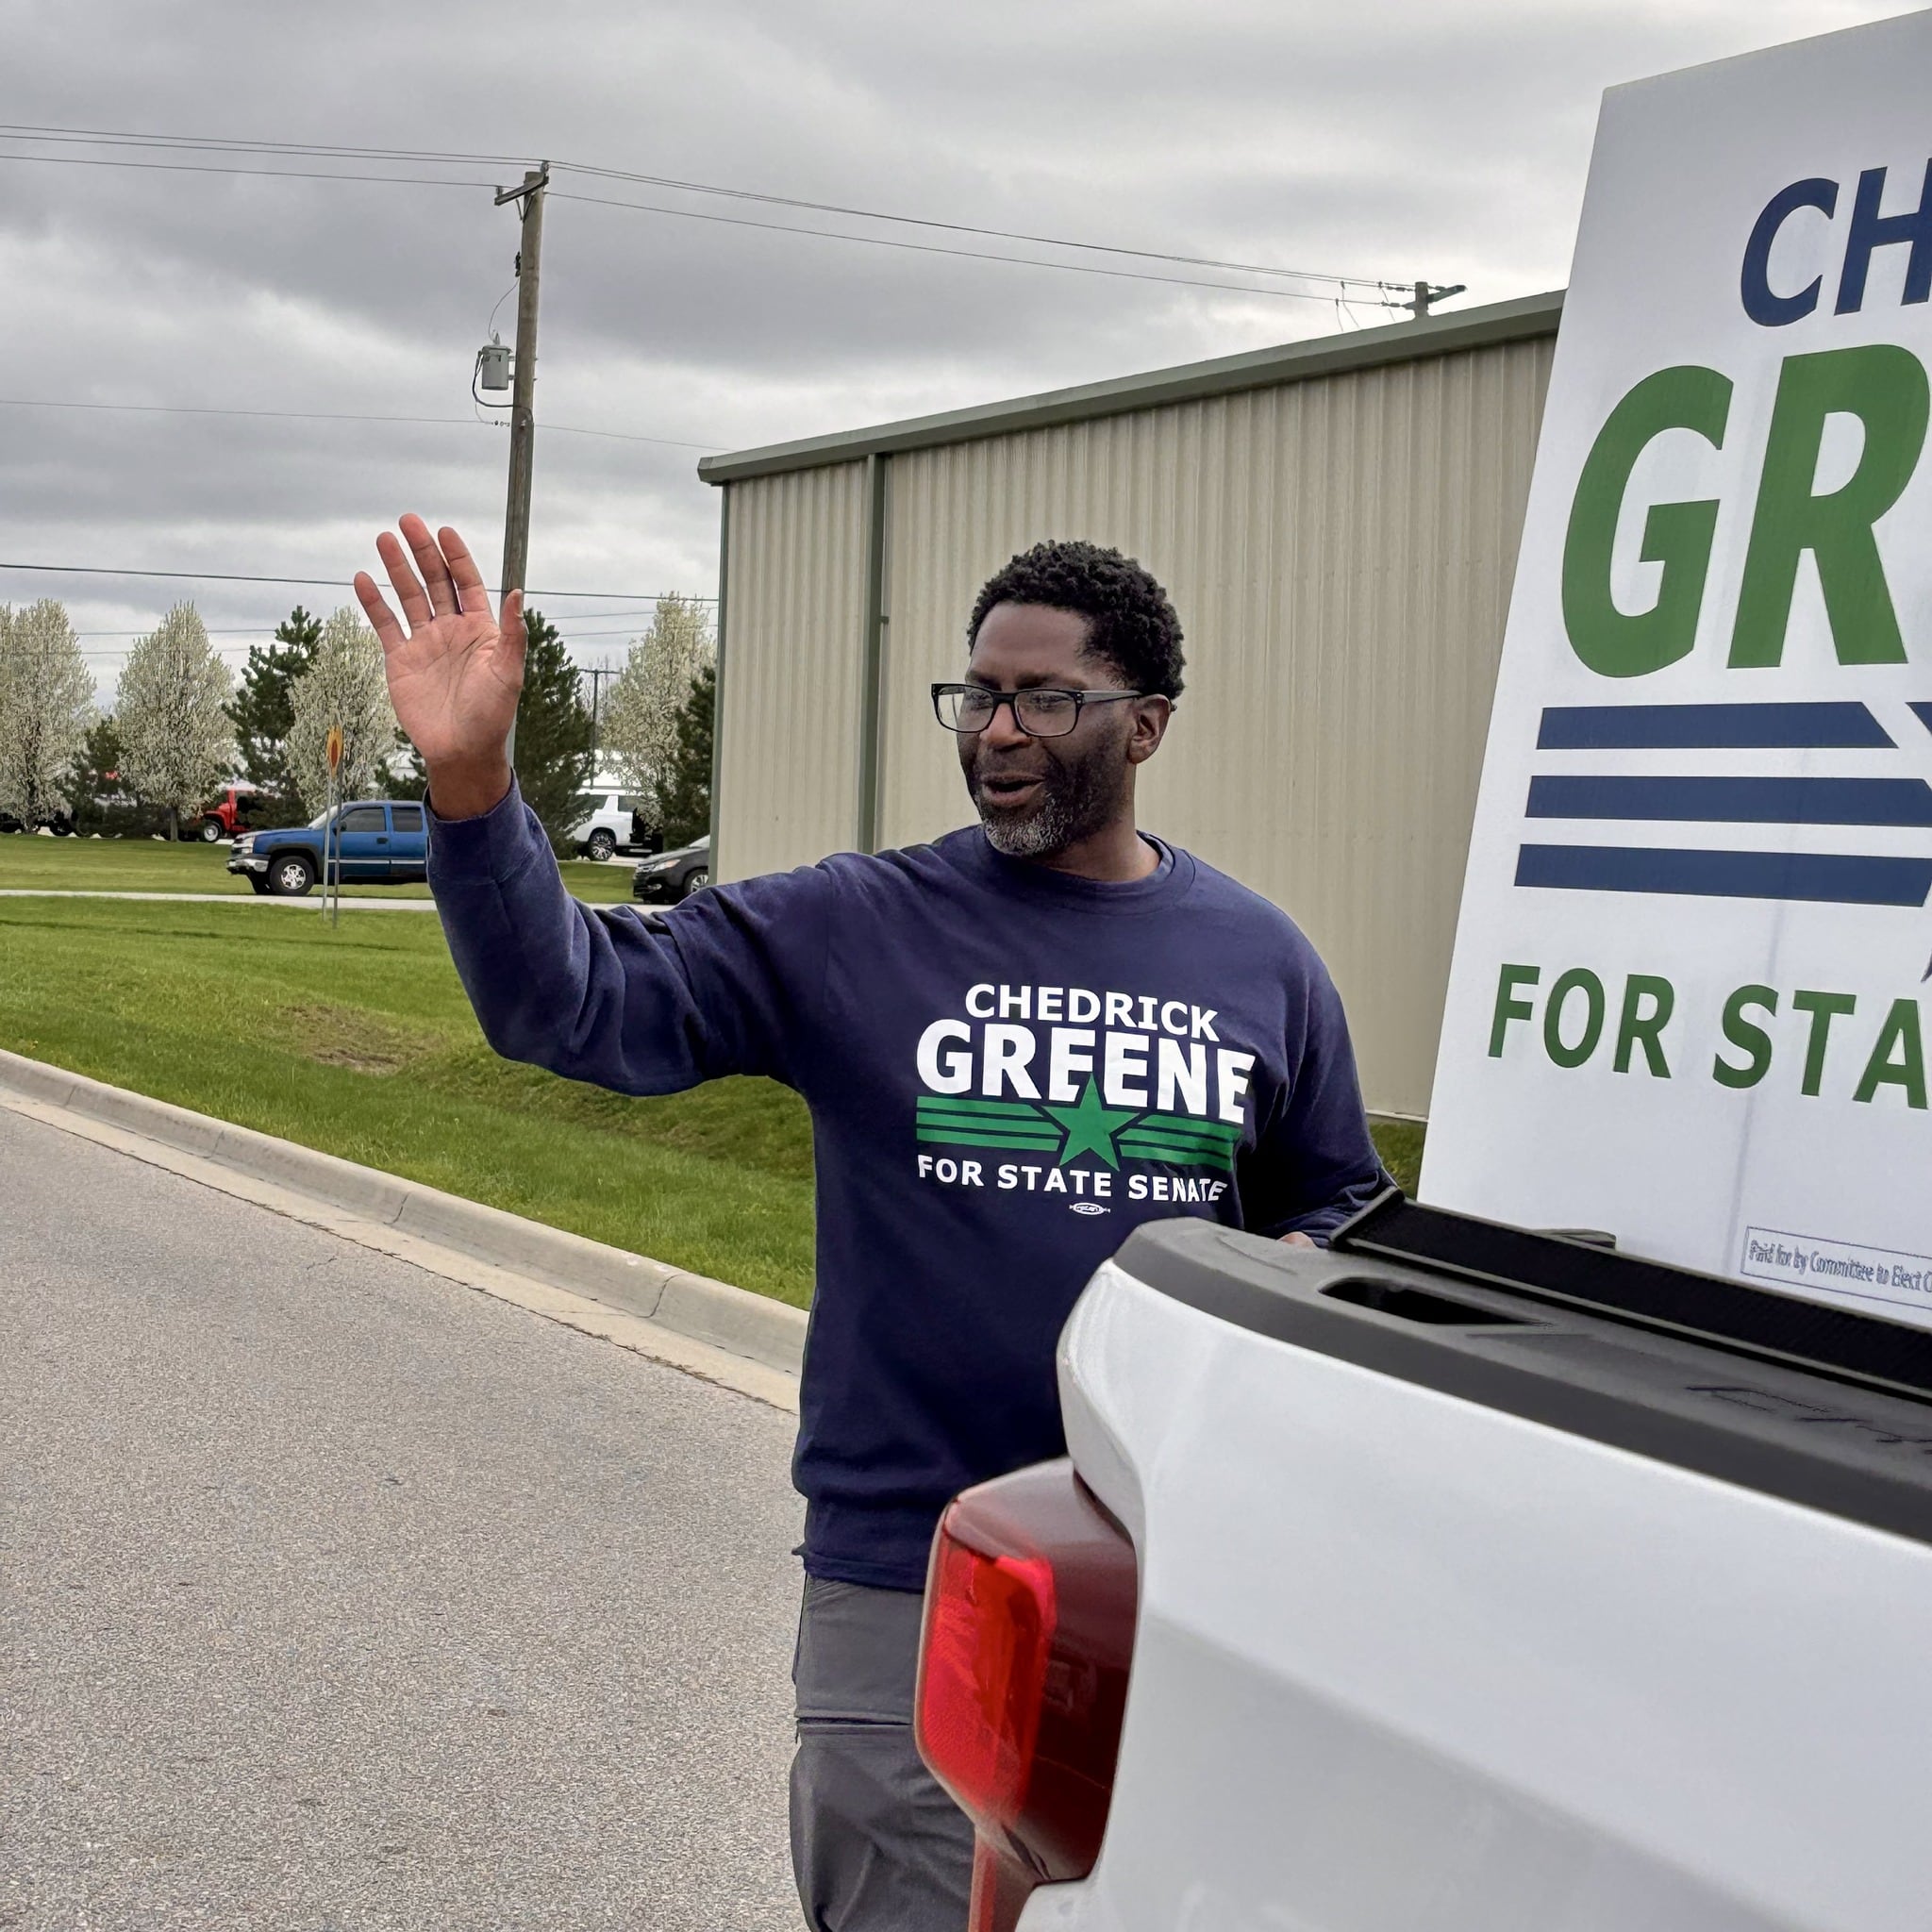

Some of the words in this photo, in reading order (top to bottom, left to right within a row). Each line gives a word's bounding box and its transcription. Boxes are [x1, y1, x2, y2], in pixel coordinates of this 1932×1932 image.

[1740, 158, 1932, 327] CH
[1561, 343, 1931, 678] GR
[965, 983, 1220, 1041] CHEDRICK
[1488, 963, 1672, 1079] FOR
[1712, 984, 1928, 1109] STA
[916, 1018, 1257, 1124] GREENE
[917, 1154, 985, 1187] FOR
[997, 1164, 1112, 1197] STATE
[1127, 1174, 1228, 1203] SENATE
[1809, 1250, 1874, 1283] Committee
